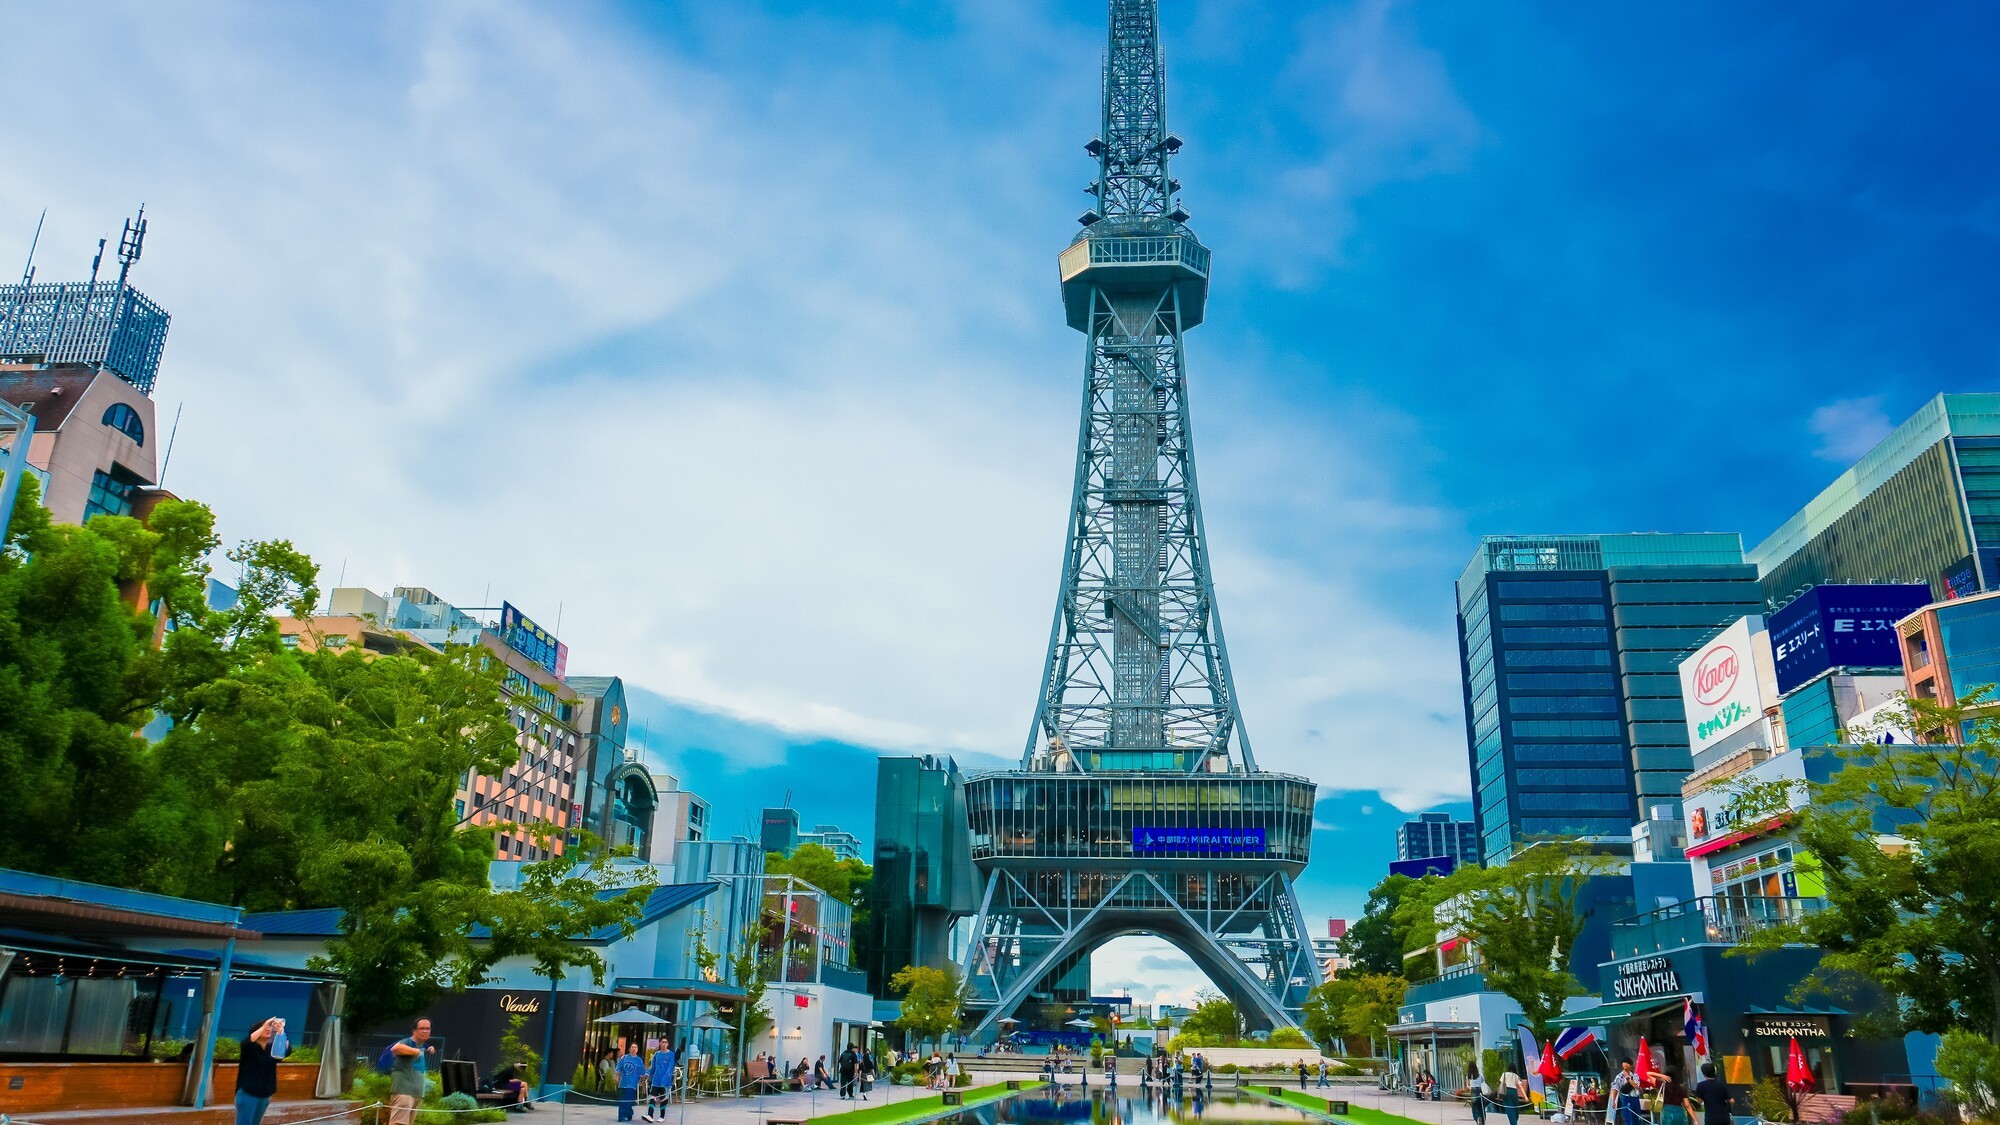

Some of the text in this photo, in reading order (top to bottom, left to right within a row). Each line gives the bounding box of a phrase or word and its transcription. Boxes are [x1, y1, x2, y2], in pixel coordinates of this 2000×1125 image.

[1789, 622, 1820, 652] エスリード
[1697, 654, 1737, 698] Kowa
[1223, 836, 1259, 844] TOWER
[1614, 971, 1679, 998] SUKHONTHA
[500, 994, 540, 1013] Venchi
[1755, 1027, 1826, 1037] SUKHONTHA
